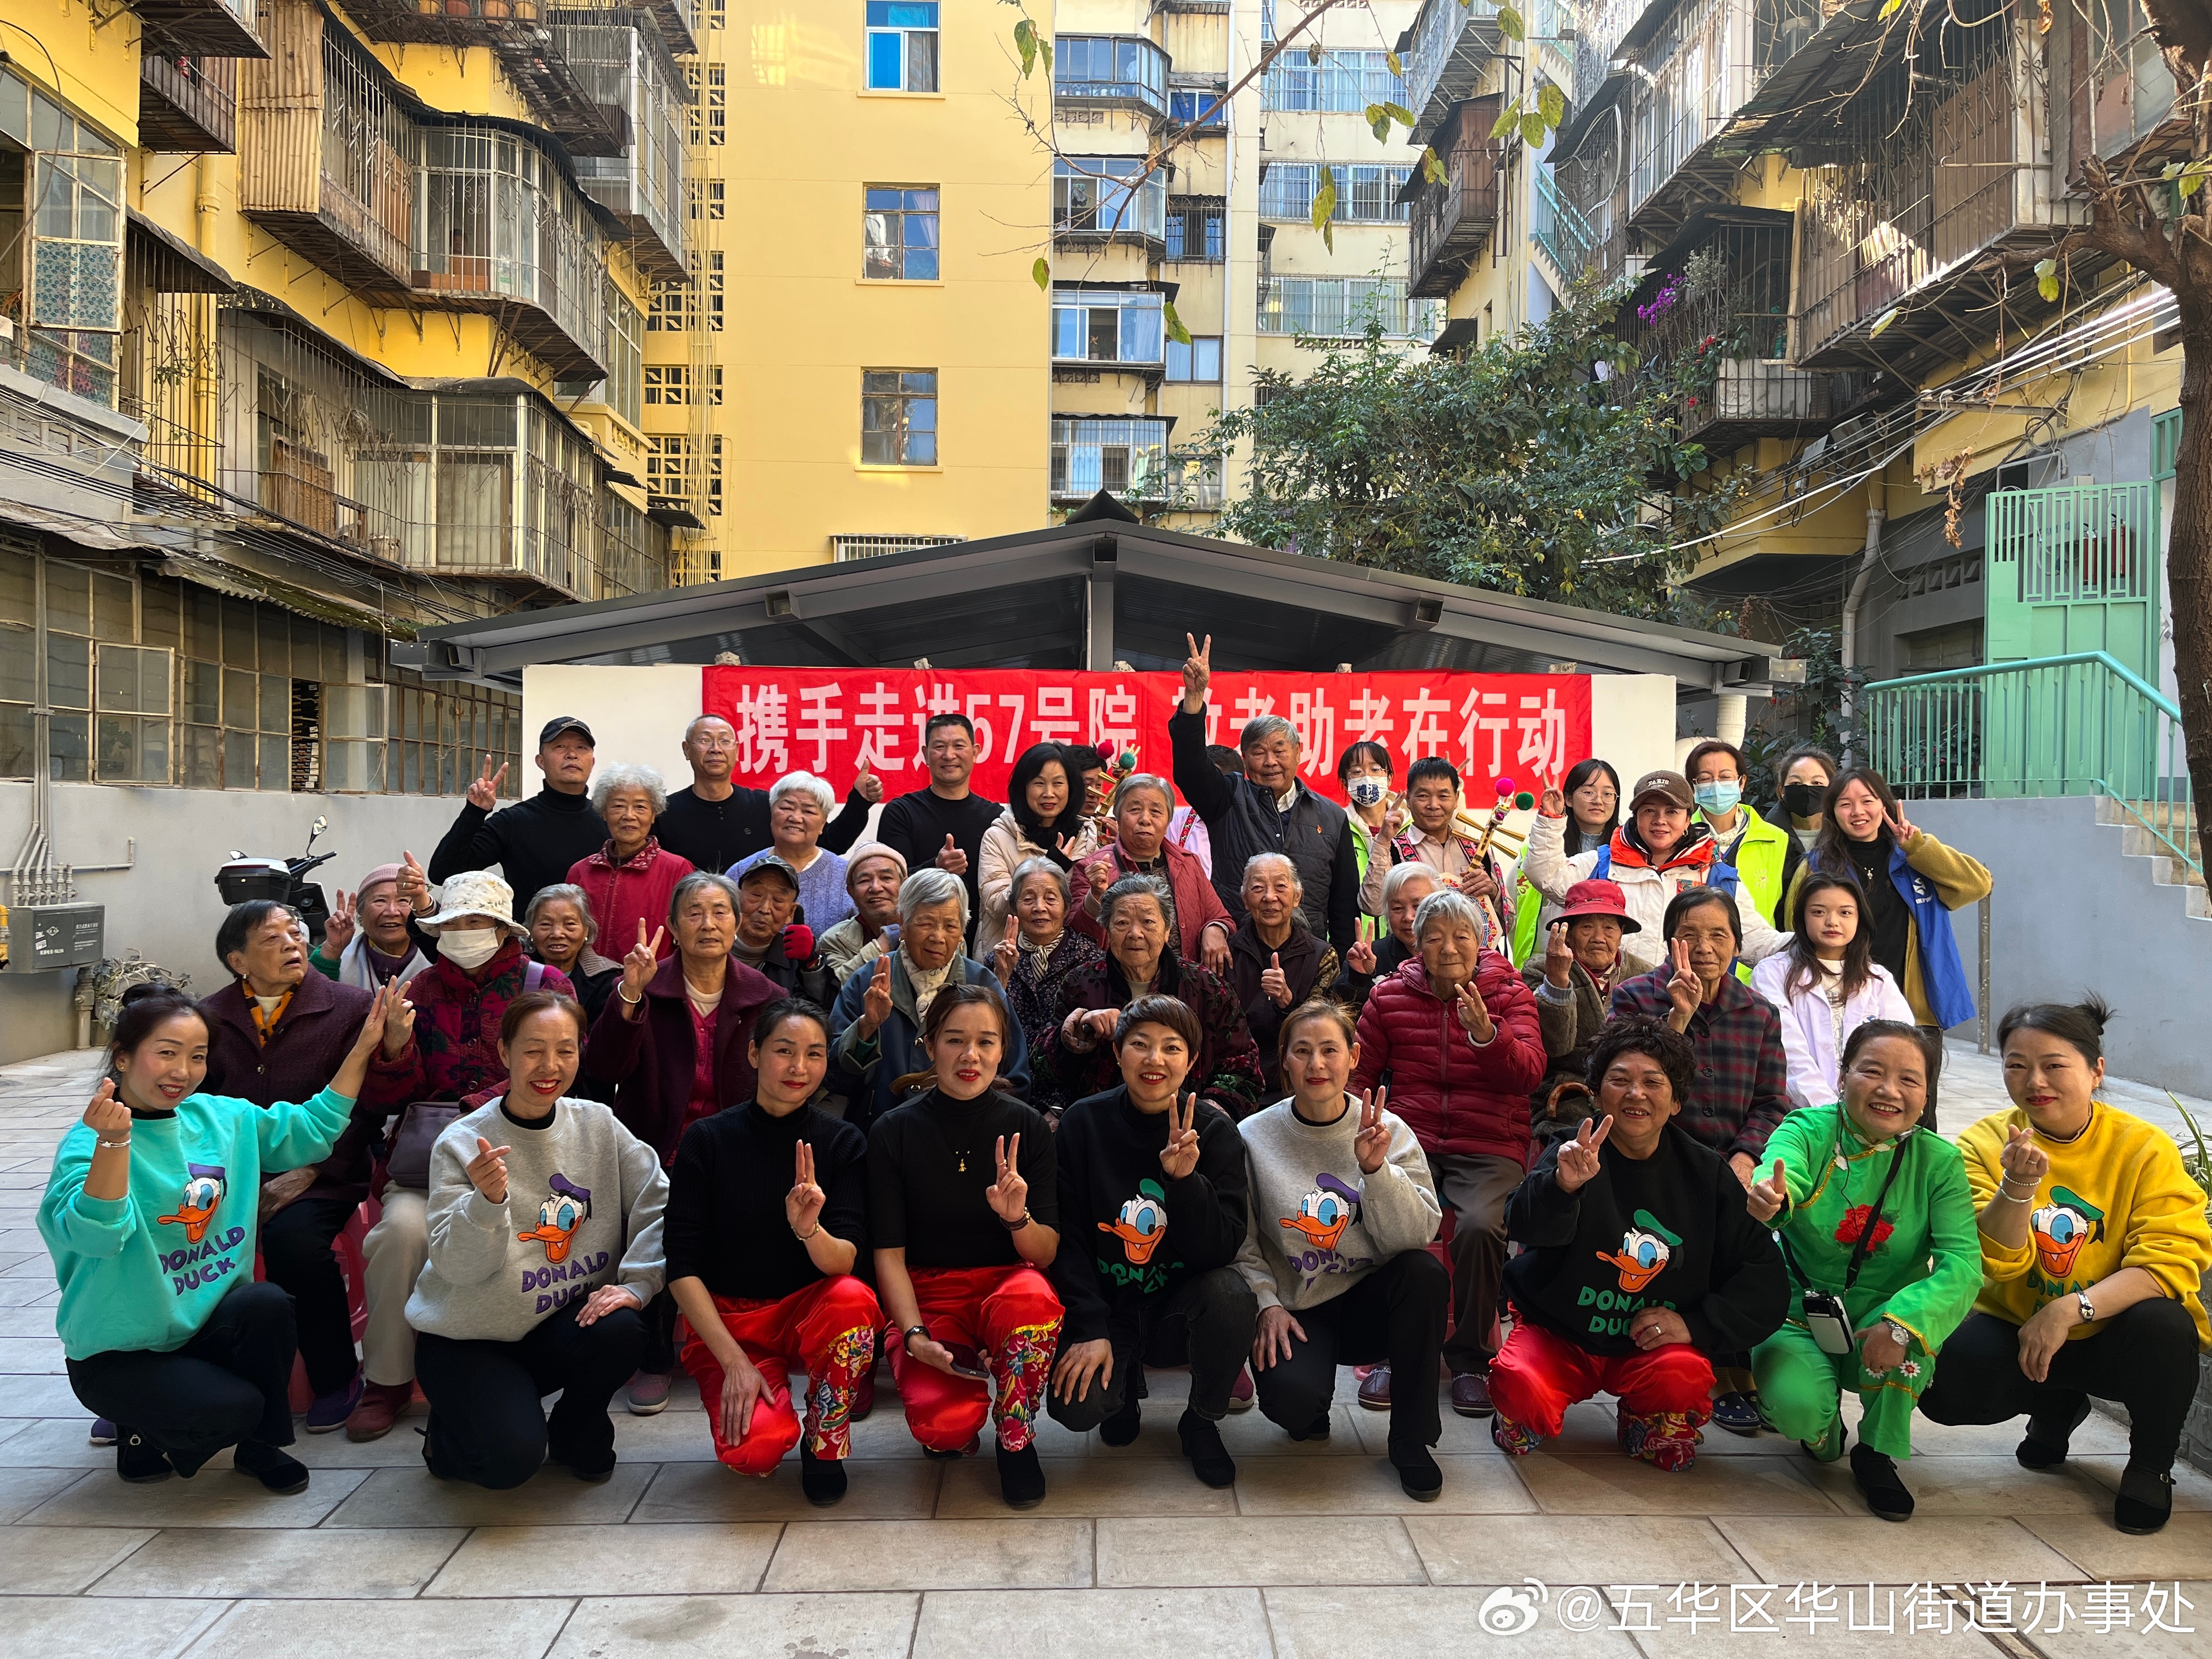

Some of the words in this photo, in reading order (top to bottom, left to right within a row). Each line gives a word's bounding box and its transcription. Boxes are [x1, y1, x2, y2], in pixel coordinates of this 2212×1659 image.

[158, 1227, 245, 1274] DONALD
[172, 1257, 235, 1296] DUCK
[522, 1251, 608, 1293] DONALD
